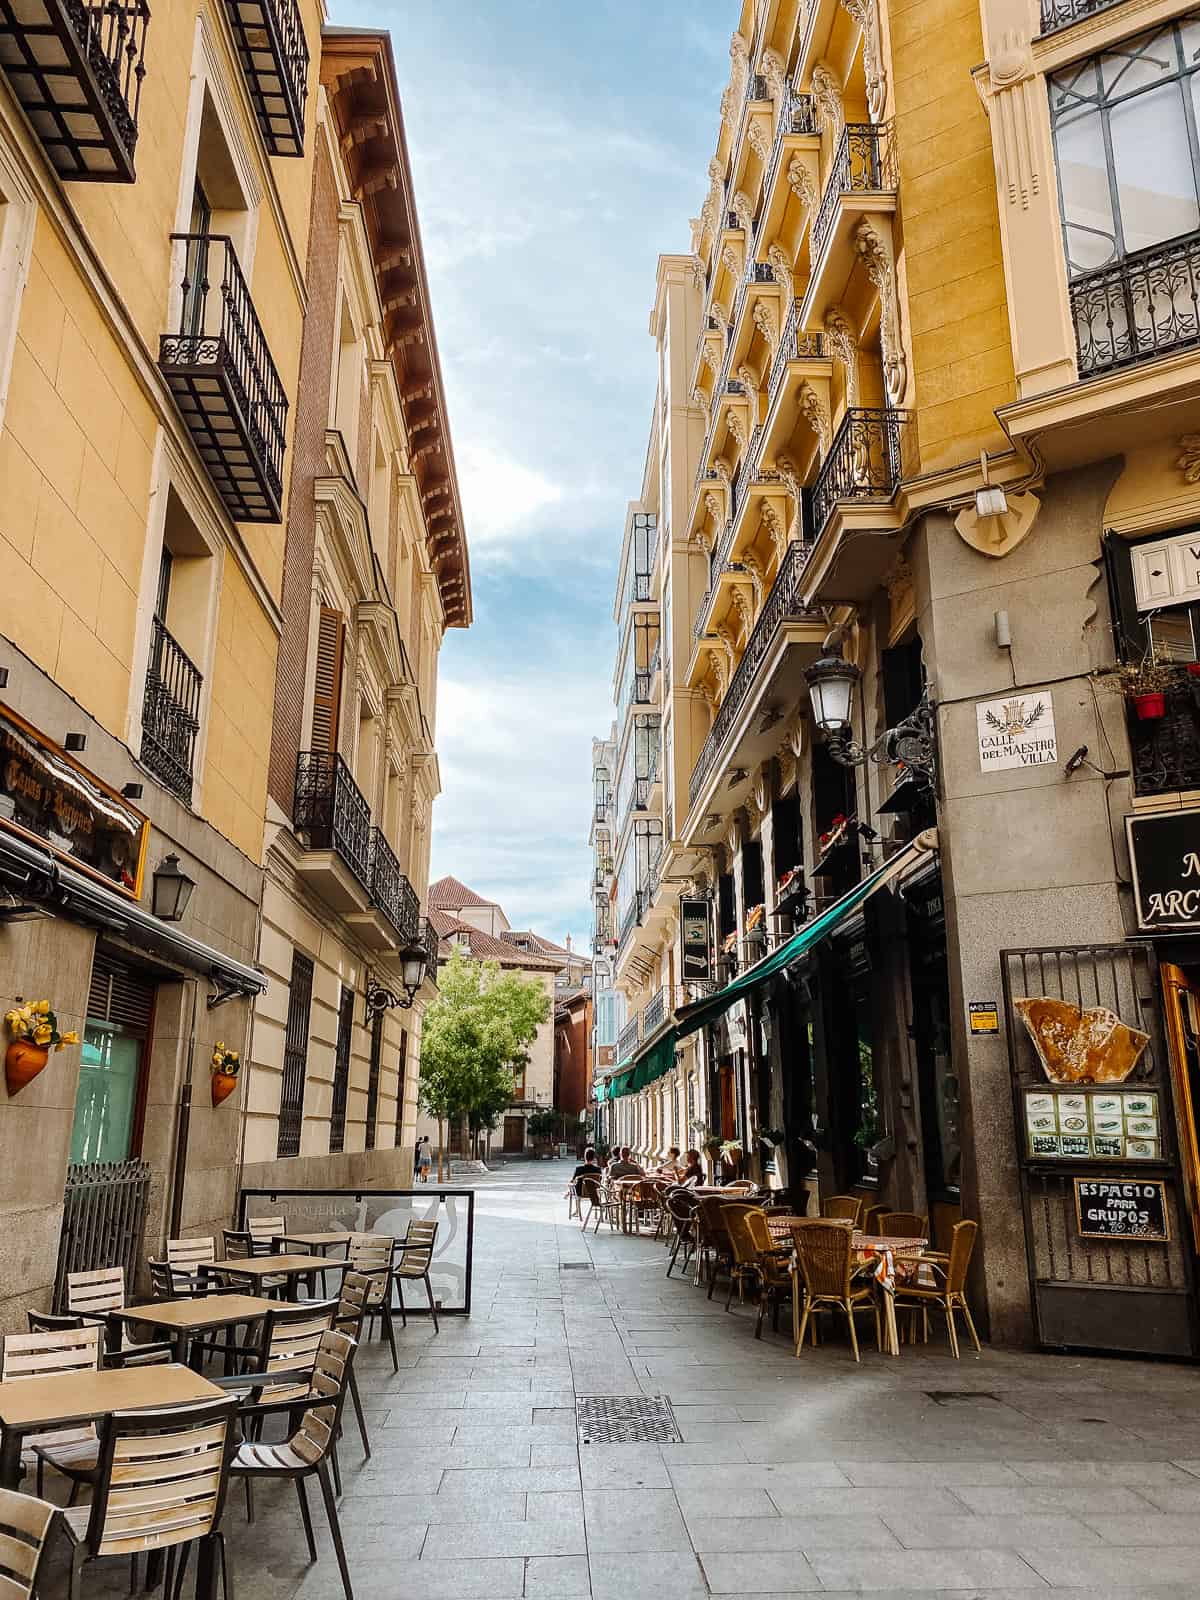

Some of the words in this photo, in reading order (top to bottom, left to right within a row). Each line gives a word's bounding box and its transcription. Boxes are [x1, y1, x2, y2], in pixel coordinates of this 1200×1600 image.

[981, 735, 1015, 748] CALLE
[982, 750, 1003, 760] DEL
[1003, 739, 1055, 756] MAESTRO
[1020, 751, 1056, 765] VILLA
[1079, 1183, 1155, 1198] ESPACIO
[1106, 1198, 1137, 1209] PARA
[1087, 1208, 1149, 1223] GRUPOS
